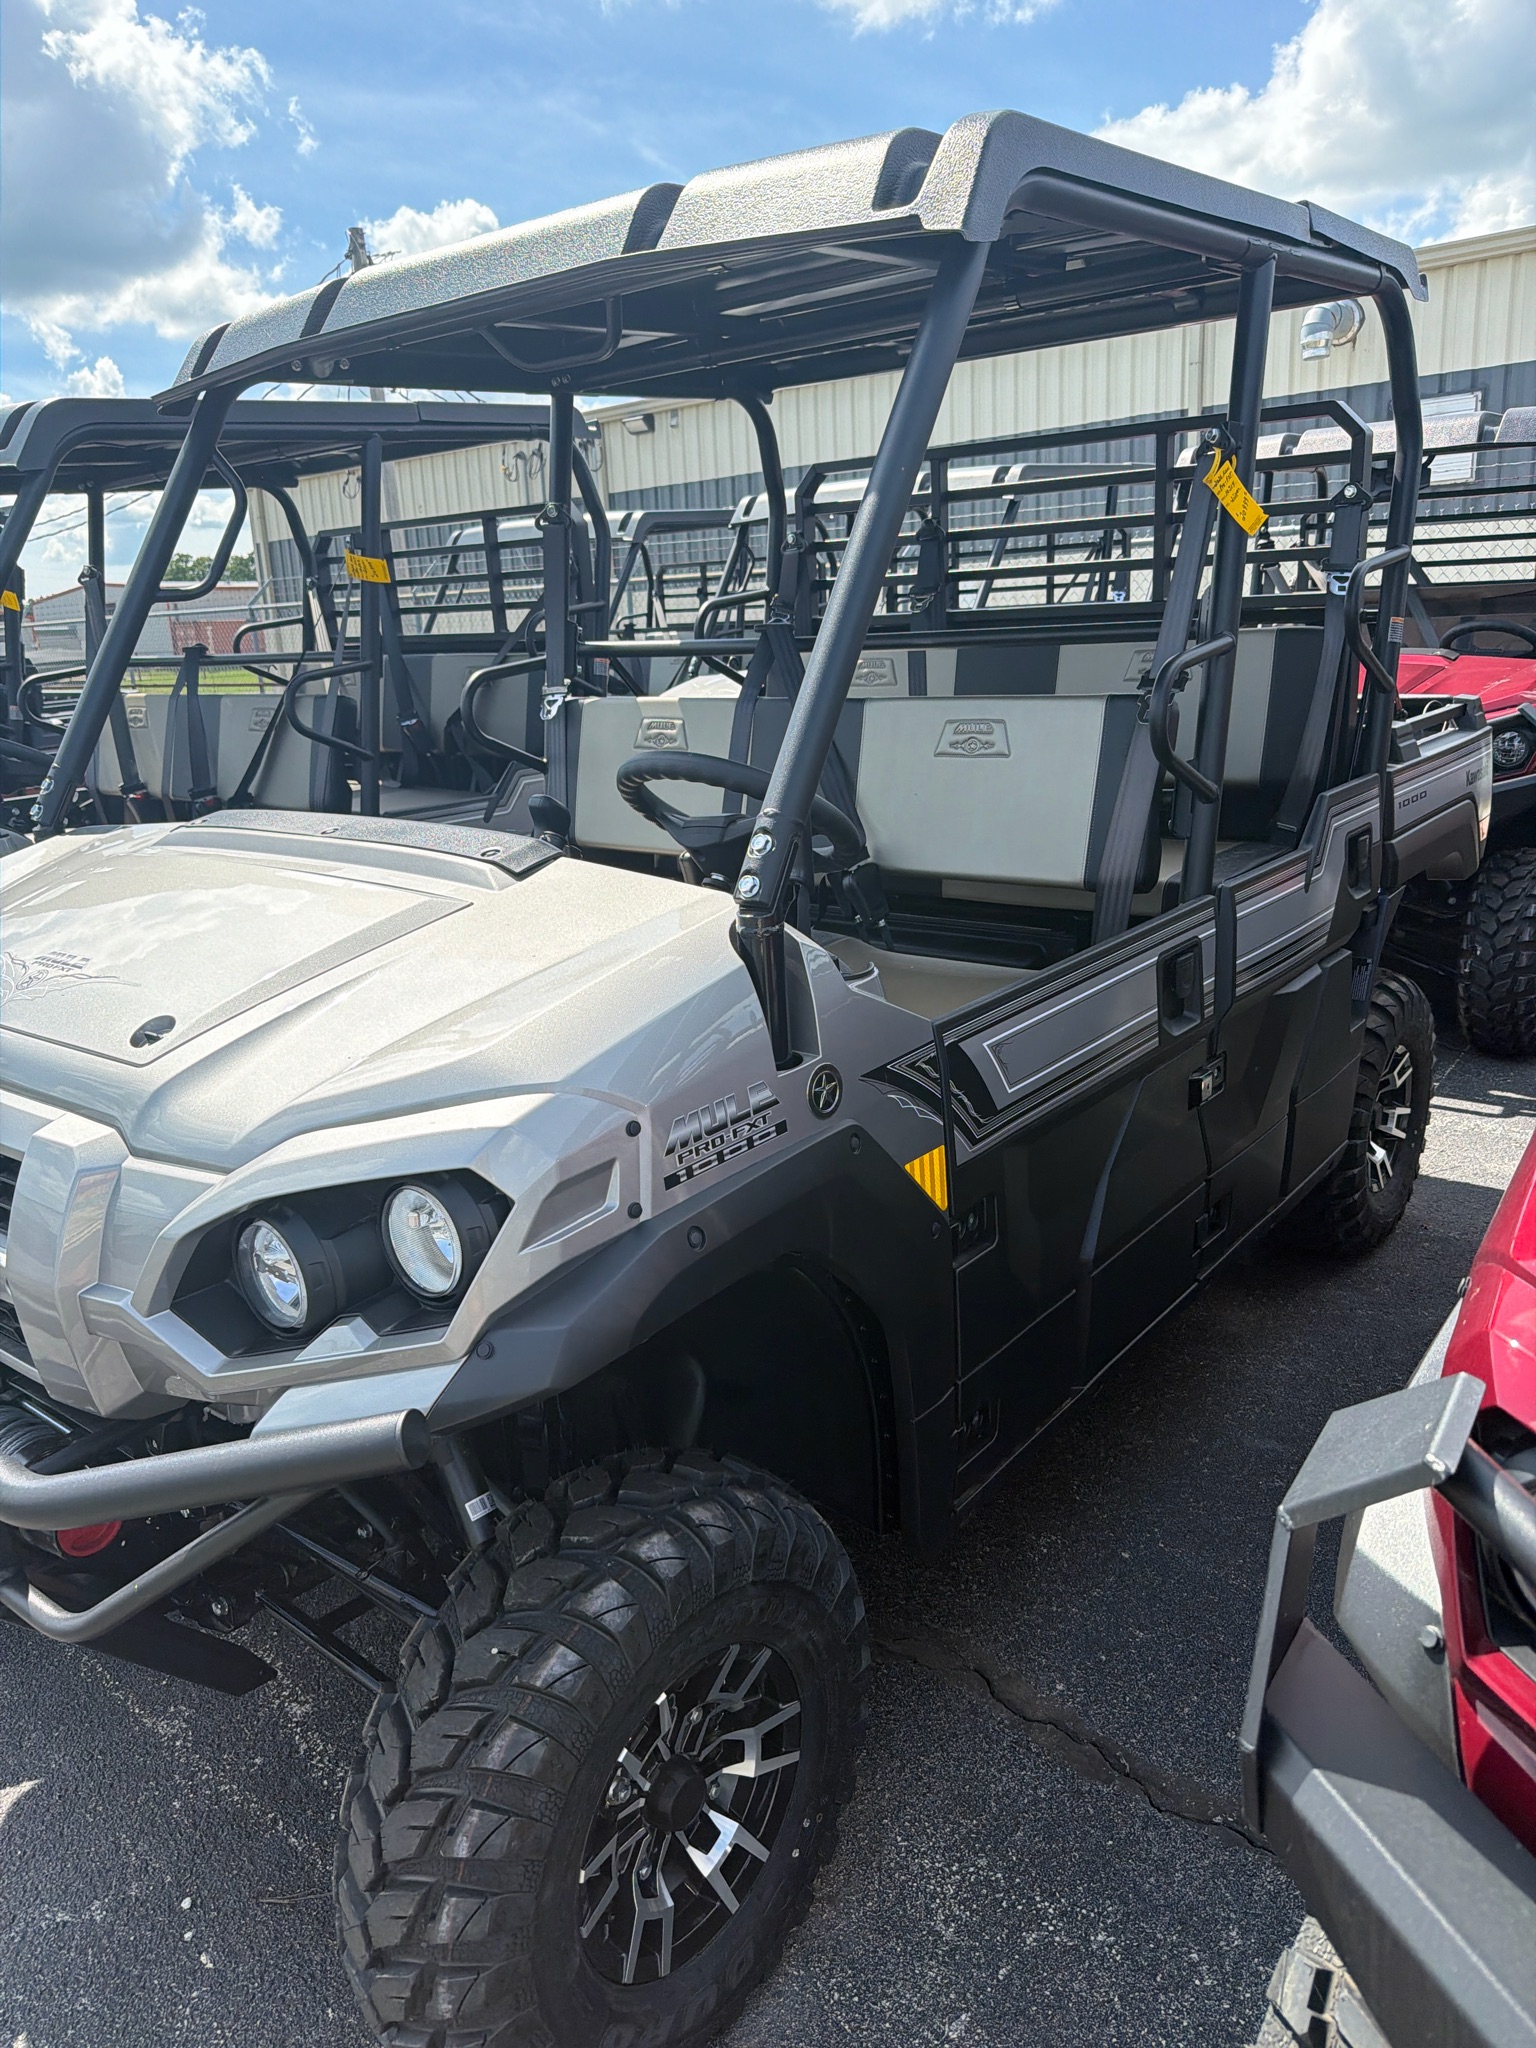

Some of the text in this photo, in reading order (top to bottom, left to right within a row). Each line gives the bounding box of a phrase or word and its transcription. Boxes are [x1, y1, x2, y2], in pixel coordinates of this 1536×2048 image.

[954, 722, 994, 734] MULE
[1398, 790, 1427, 809] 1000
[664, 1080, 781, 1157] MULE
[675, 1111, 772, 1166] PRO-FXT
[675, 1125, 779, 1183] 1000
